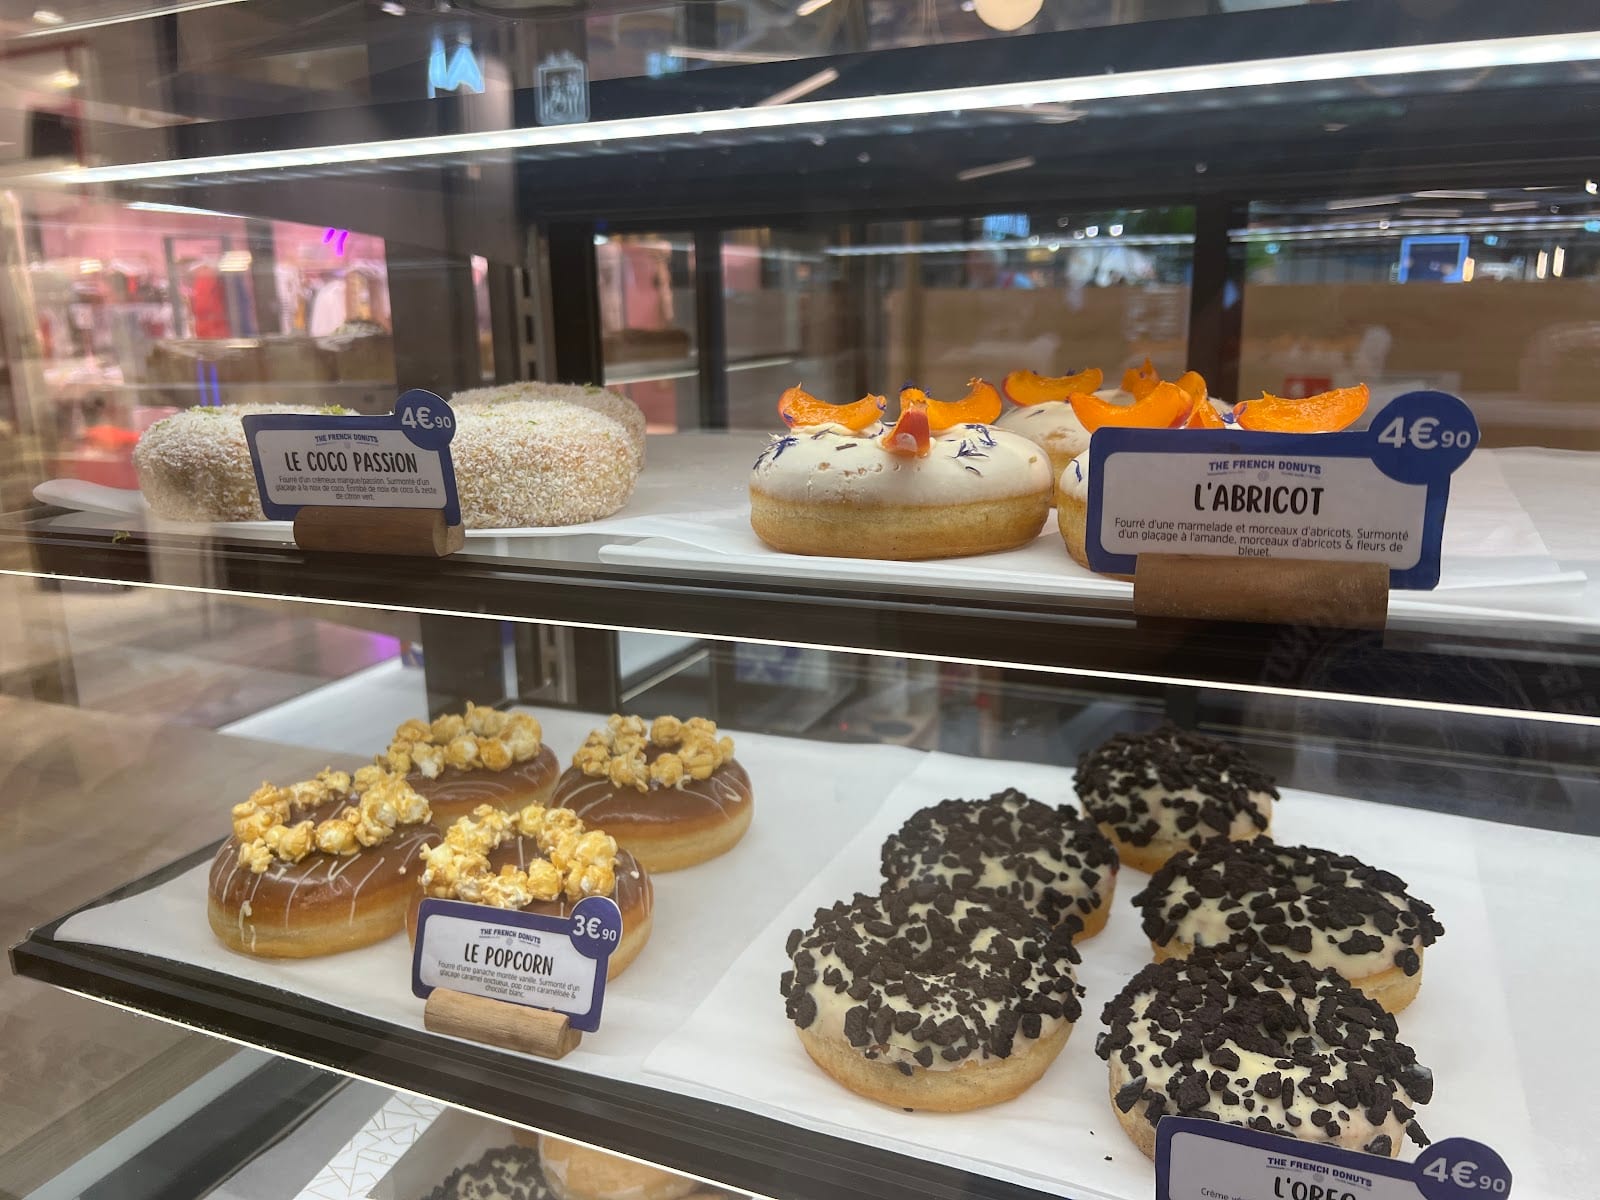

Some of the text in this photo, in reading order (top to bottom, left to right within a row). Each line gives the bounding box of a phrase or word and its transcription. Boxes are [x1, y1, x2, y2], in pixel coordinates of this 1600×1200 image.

[314, 433, 379, 443] THE FRENCH DONUTS
[284, 451, 302, 472] LE
[306, 451, 348, 472] COCO
[1208, 460, 1229, 471] THE
[1232, 459, 1275, 470] FRENCH
[1278, 460, 1322, 475] DONUTS
[1194, 482, 1325, 516] L'ABRICOT
[1114, 517, 1409, 541] Fourré d'une marmelade et morceaux d'abricots. Surmonté
[1118, 529, 1139, 539] d'un
[1141, 530, 1178, 542] glaçage
[1180, 531, 1187, 542] à
[1239, 535, 1289, 547] morceaux
[1292, 537, 1342, 550] d'abricots
[1344, 540, 1353, 550] &
[1357, 540, 1386, 552] fleurs
[1389, 541, 1403, 553] de
[1238, 545, 1272, 557] bleuet.
[480, 928, 492, 936] THE
[493, 928, 517, 937] FRENCH
[518, 932, 542, 944] DONUTS
[464, 943, 554, 977] LE POPCORN
[456, 964, 472, 973] d'une
[472, 967, 496, 977] ganache
[496, 971, 518, 981] montée
[539, 977, 567, 990] Surmonté
[567, 982, 580, 992] d'un
[461, 972, 483, 983] caramel
[510, 981, 523, 991] pop
[571, 990, 577, 1000] &
[484, 984, 508, 996] chocolat
[1267, 1157, 1287, 1167] THE
[1290, 1160, 1330, 1175] FRENCH
[1332, 1169, 1373, 1188] DONUTS
[1200, 1186, 1230, 1200] Crème
